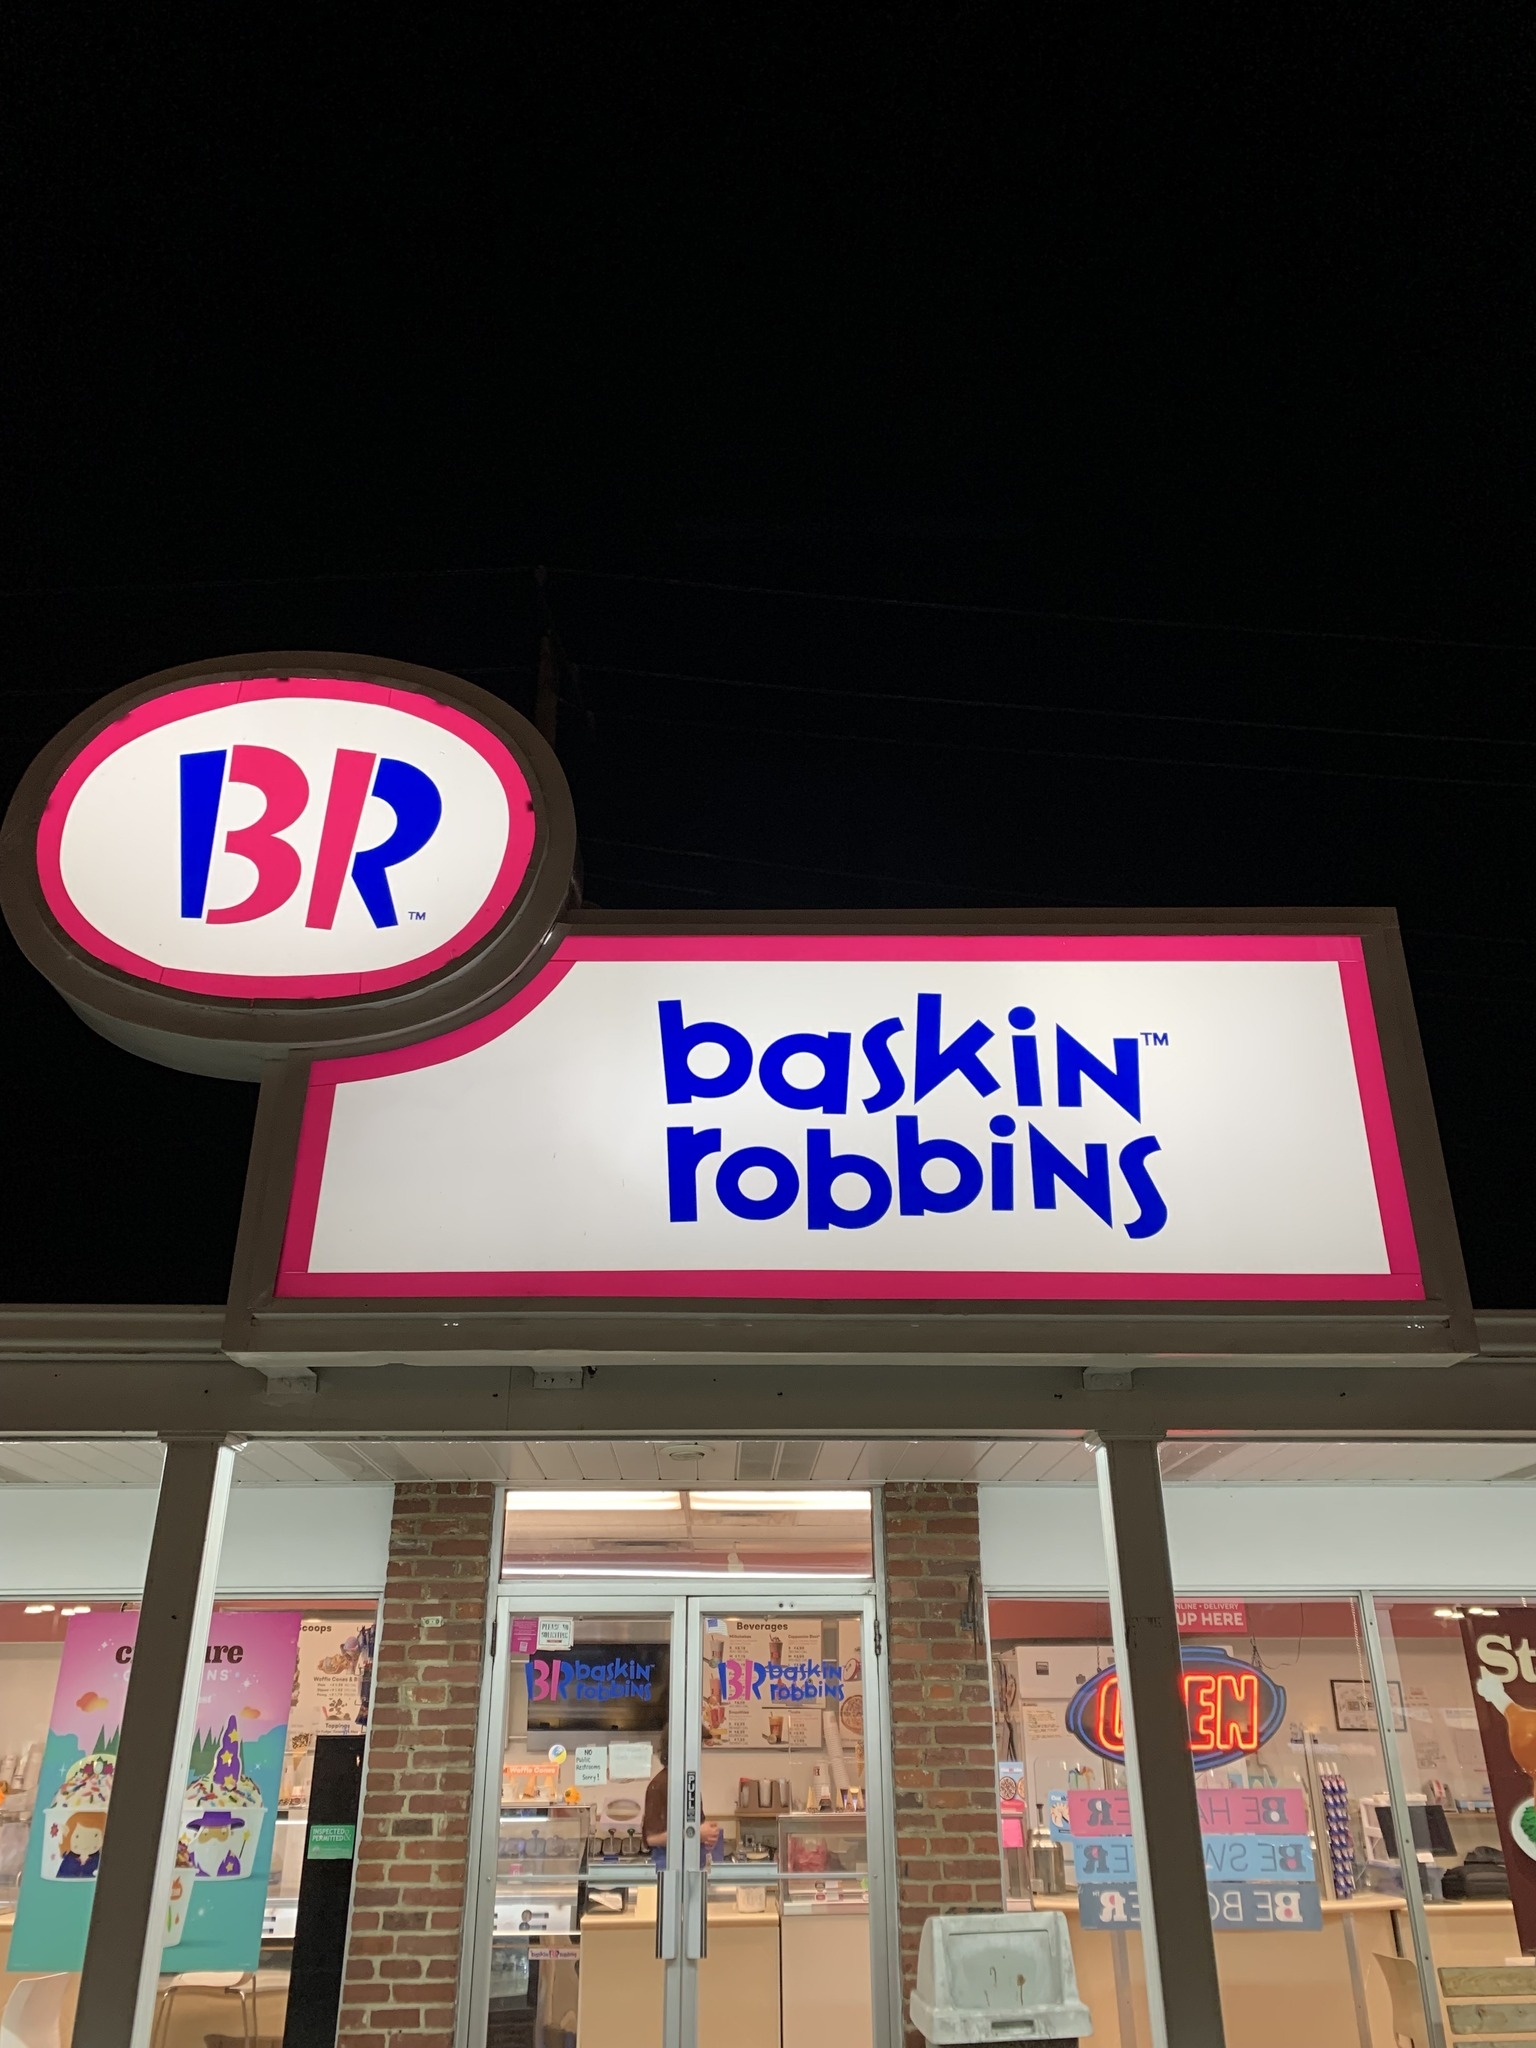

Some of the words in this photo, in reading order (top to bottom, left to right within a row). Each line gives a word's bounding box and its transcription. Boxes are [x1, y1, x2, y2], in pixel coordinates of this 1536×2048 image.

[180, 744, 442, 930] BR
[300, 1625, 332, 1634] coops
[736, 1621, 789, 1633] Beverages
[1201, 1612, 1244, 1626] HERE
[524, 1659, 575, 1701] BR
[717, 1658, 767, 1701] BR
[1097, 1674, 1259, 1751] OEN
[687, 1775, 696, 1810] PULL
